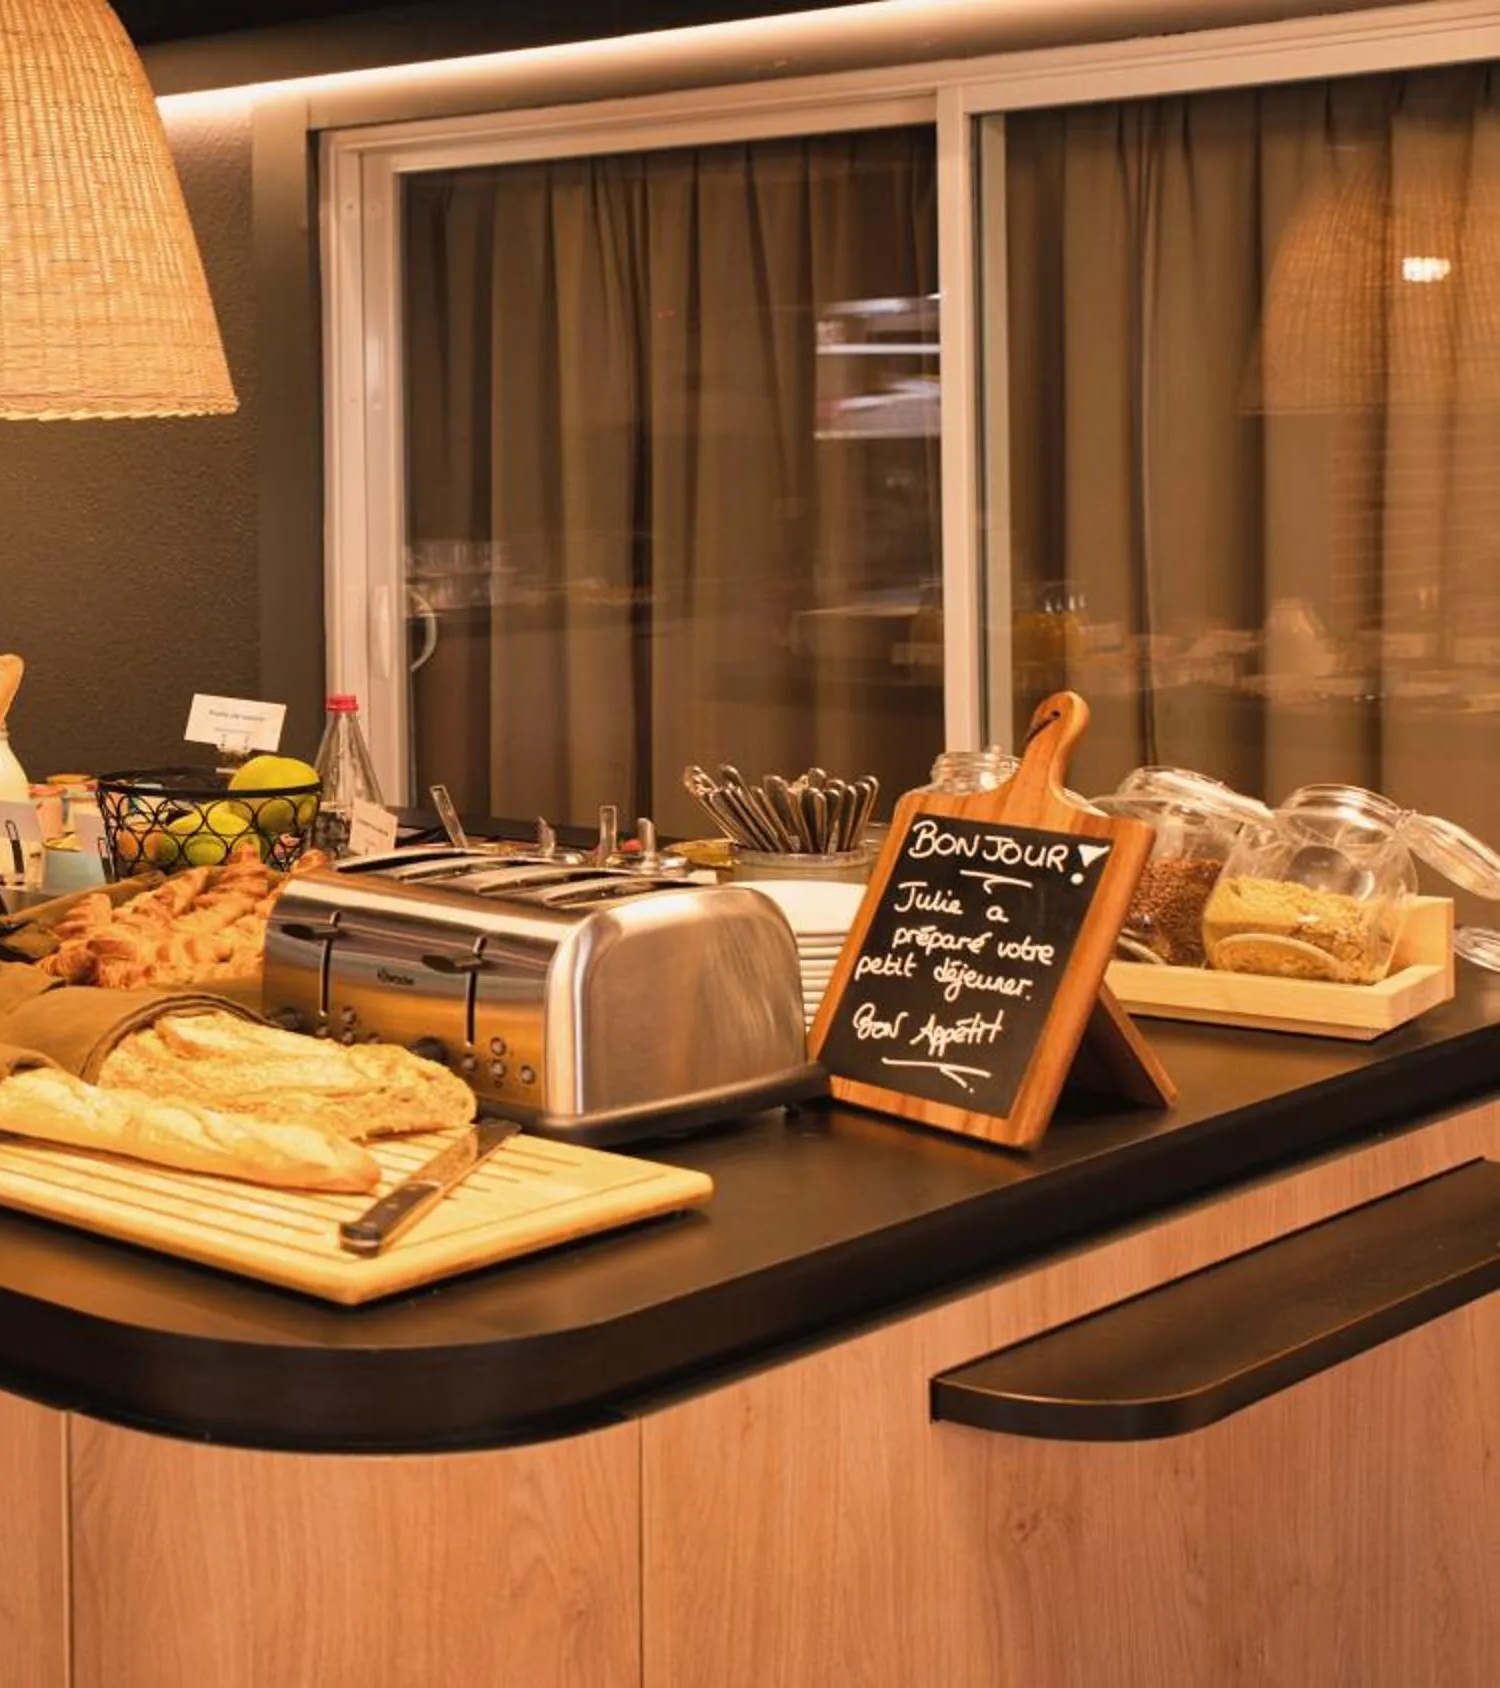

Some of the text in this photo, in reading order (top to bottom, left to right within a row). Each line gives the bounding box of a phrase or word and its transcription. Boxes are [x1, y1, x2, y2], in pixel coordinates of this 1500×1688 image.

[893, 881, 1010, 923] Julie a
[891, 924, 1055, 966] préparé votre
[854, 951, 1033, 1003] petit déjeuner.
